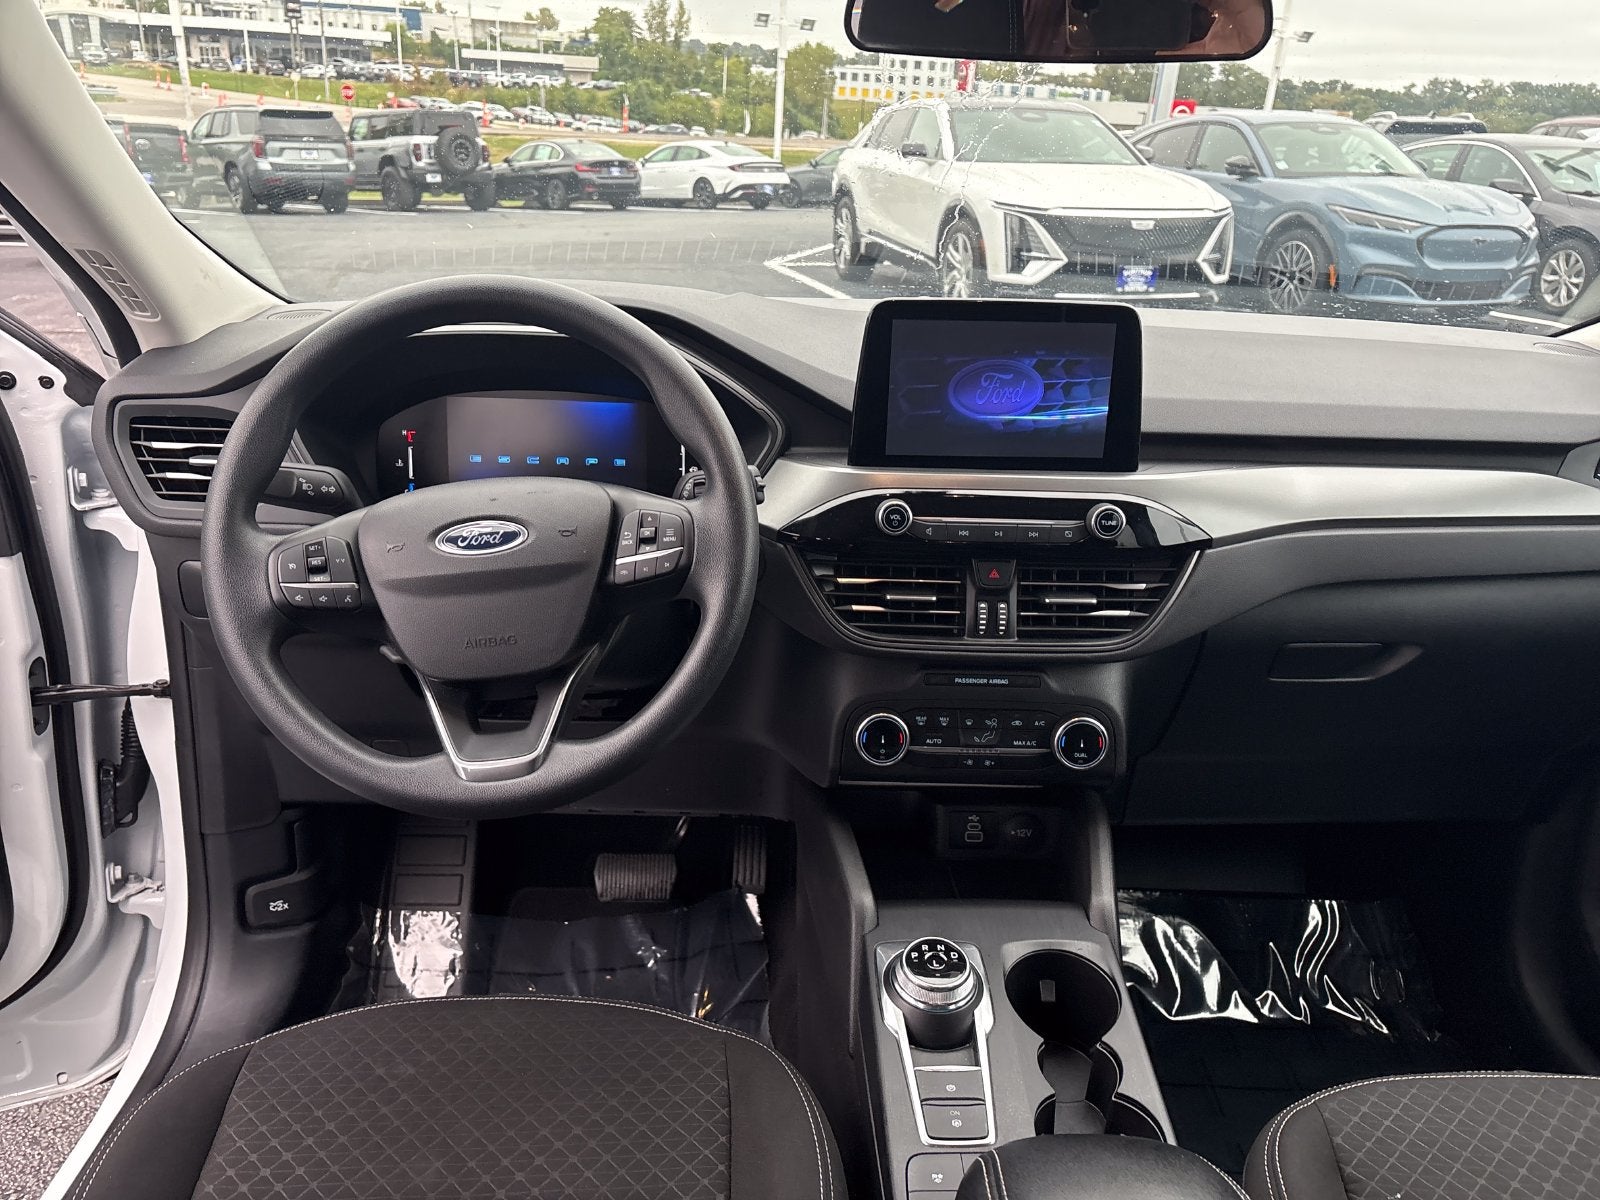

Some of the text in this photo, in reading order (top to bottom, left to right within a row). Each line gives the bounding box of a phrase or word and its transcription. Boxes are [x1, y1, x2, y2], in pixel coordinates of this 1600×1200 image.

[976, 372, 1025, 405] Ford
[457, 526, 505, 547] Ford
[464, 635, 517, 649] AIRBAG
[932, 959, 940, 967] L
